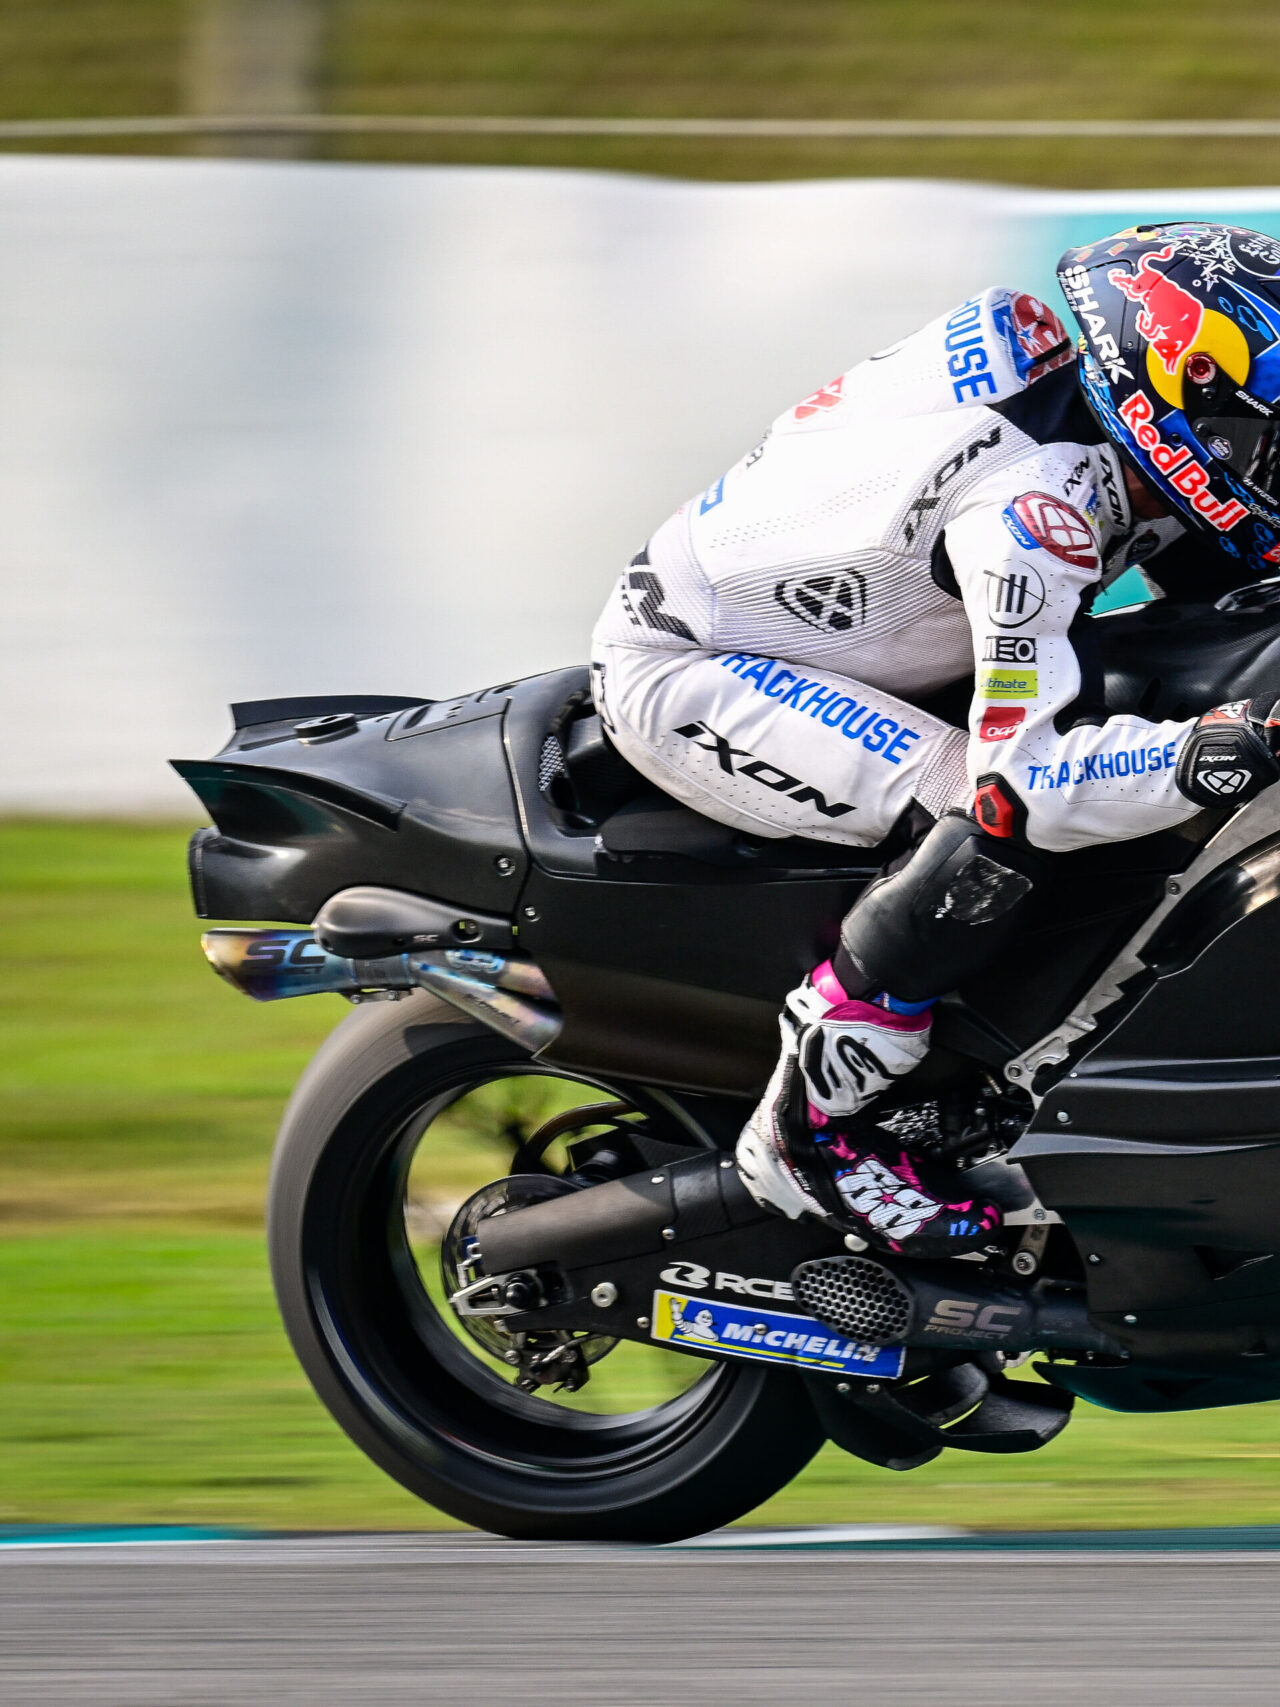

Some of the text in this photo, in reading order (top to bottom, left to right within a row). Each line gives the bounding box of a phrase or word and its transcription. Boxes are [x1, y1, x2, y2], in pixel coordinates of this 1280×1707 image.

[1064, 265, 1135, 384] SHARK
[1235, 390, 1273, 416] SHARK
[1118, 389, 1250, 531] Red Bull
[709, 651, 920, 765] RACKHOUSE
[1027, 741, 1179, 790] TRACKHOUSE
[242, 939, 327, 965] SC
[924, 1324, 1011, 1342] PROJECT
[930, 1299, 1023, 1331] SC
[721, 1322, 881, 1363] MICHELIN
